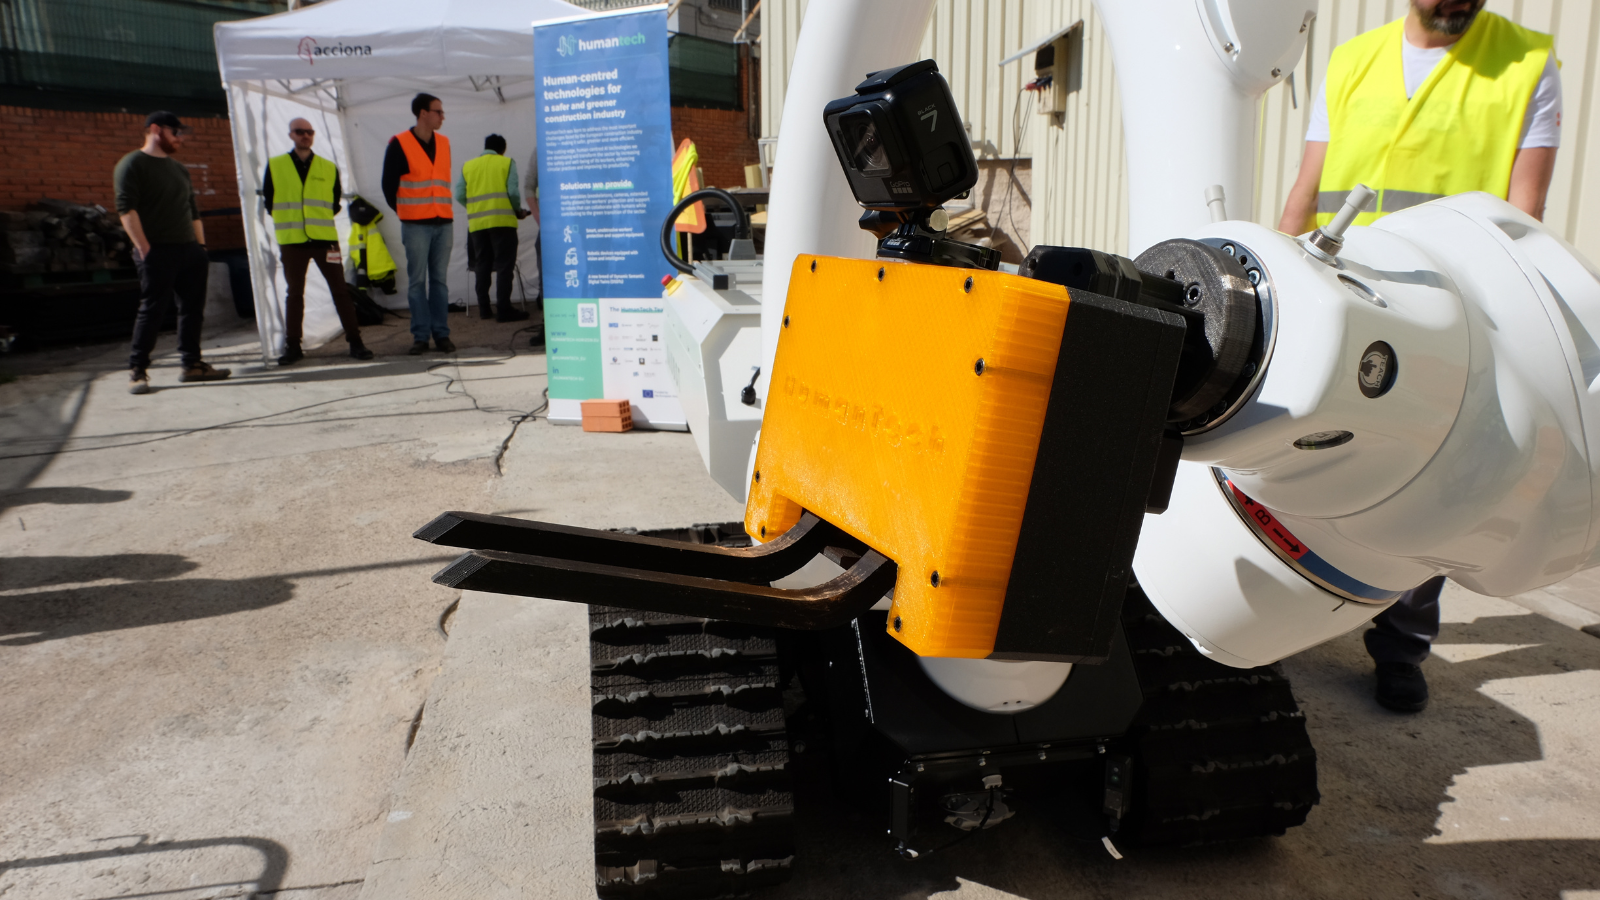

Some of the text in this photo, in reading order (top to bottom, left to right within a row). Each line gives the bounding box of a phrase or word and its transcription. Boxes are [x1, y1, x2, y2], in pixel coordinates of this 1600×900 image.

[314, 42, 372, 56] acciona
[578, 32, 646, 52] humantech
[543, 68, 618, 86] Human-centred
[544, 83, 622, 100] technologies for
[551, 103, 570, 112] safer
[571, 101, 585, 110] and
[586, 99, 617, 110] greener
[917, 103, 936, 116] BLACK
[544, 110, 626, 123] construction industry
[920, 109, 938, 133] 7
[560, 182, 591, 190] Solutions
[605, 179, 632, 189] provide
[1375, 354, 1389, 388] TEACH
[1254, 509, 1271, 526] B
